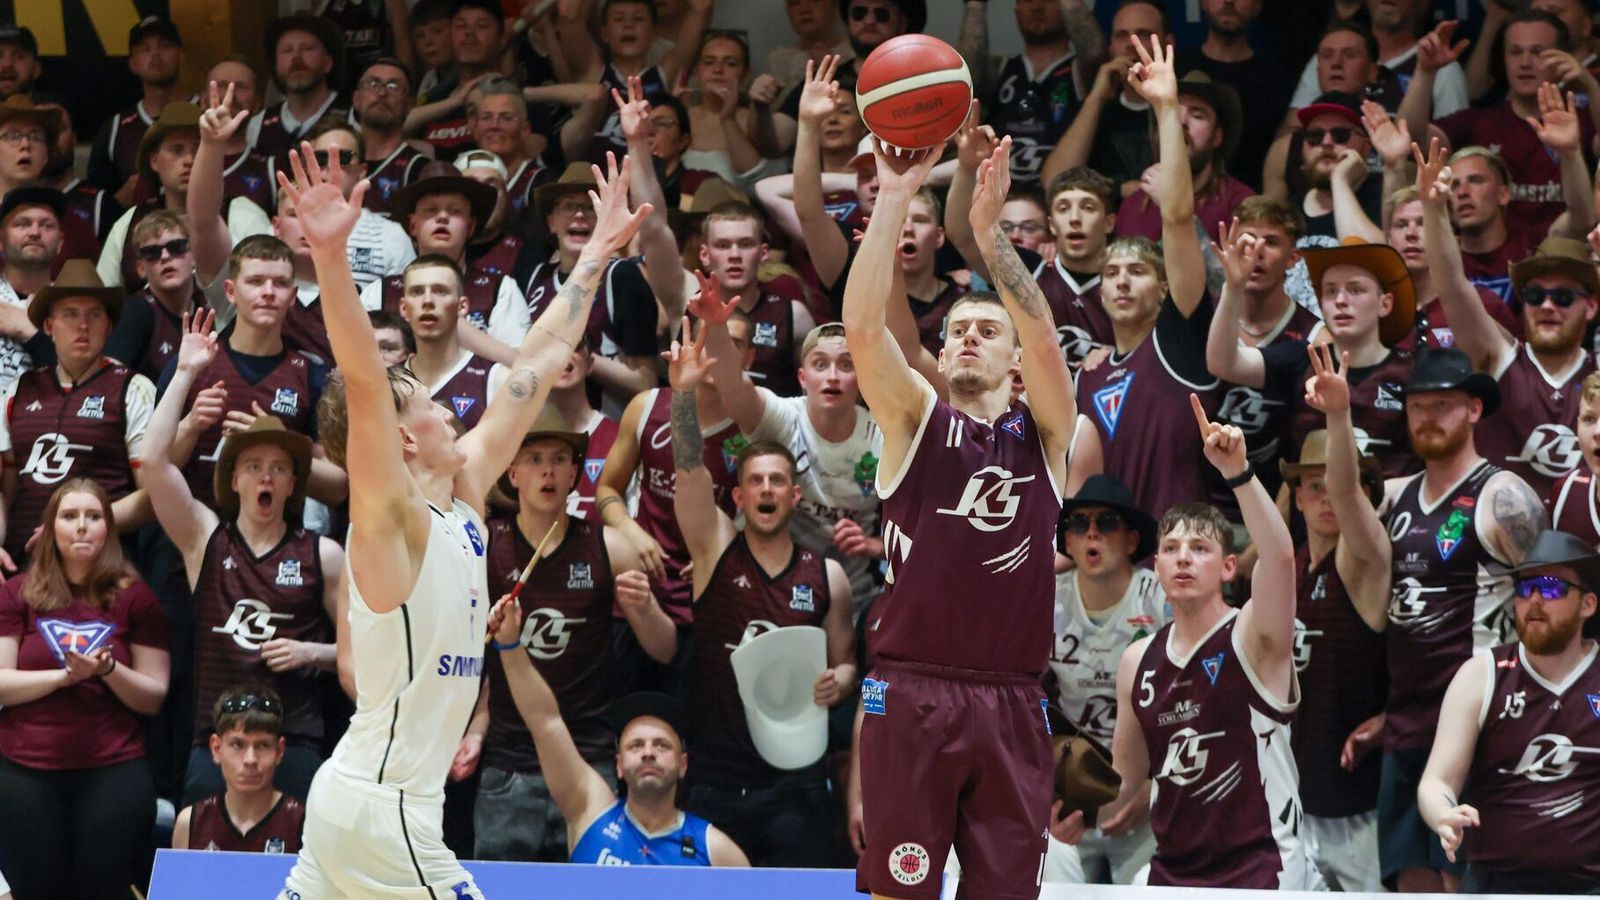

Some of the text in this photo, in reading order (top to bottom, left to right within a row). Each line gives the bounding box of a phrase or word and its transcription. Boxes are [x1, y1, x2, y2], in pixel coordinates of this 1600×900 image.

[891, 97, 944, 122] molten
[1138, 670, 1156, 708] 5
[895, 845, 928, 860] BÓNUS
[892, 868, 925, 884] DEILDIN
